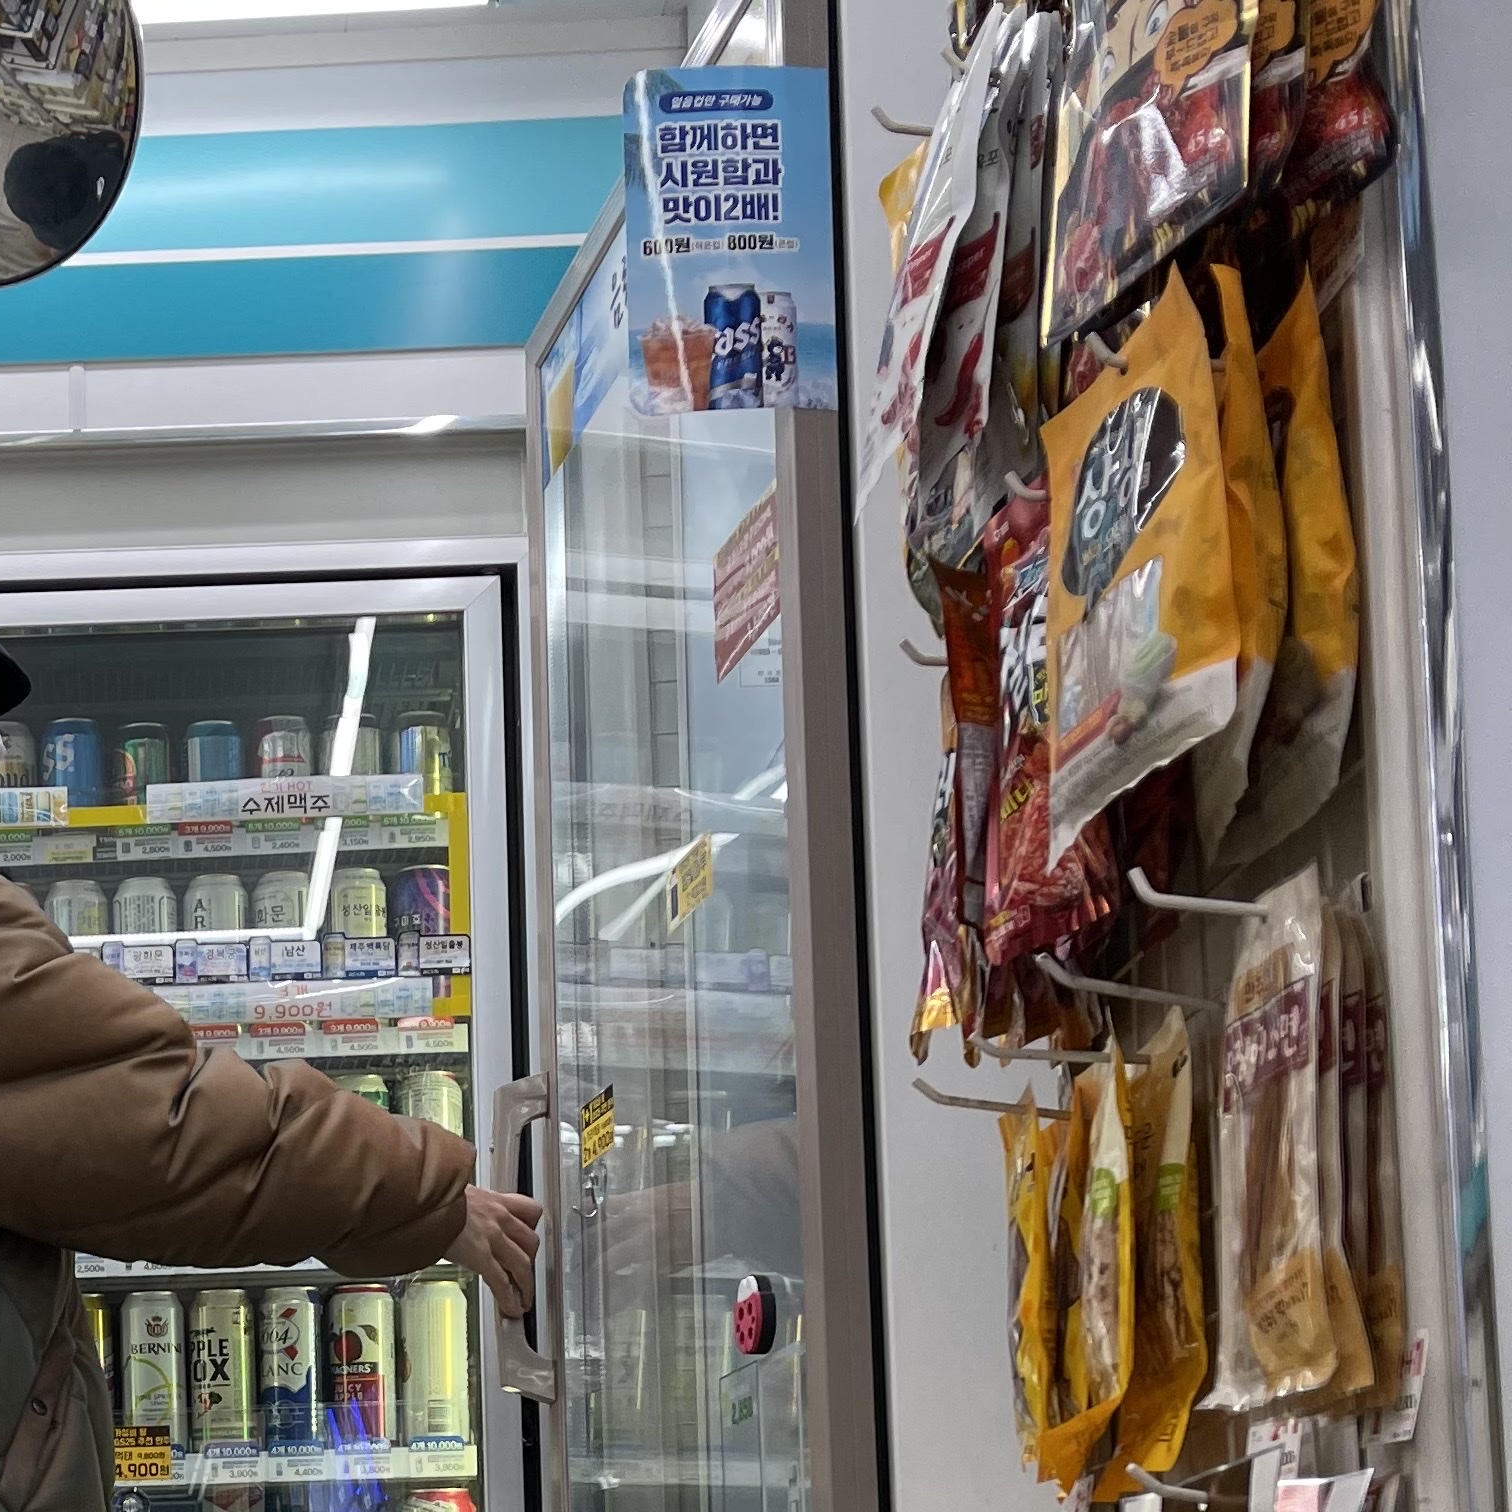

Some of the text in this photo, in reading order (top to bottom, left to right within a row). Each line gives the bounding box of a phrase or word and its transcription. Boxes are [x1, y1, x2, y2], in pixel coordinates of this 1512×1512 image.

[657, 121, 781, 154] 함께하면
[658, 156, 782, 189] 시원함과
[662, 192, 780, 225] 맛이2배!
[642, 233, 775, 257] 600원 800원
[714, 317, 762, 356] ass
[287, 780, 313, 792] HOT
[240, 792, 331, 816] 수제맥주
[254, 904, 286, 925] 화문
[284, 944, 306, 958] 남산
[254, 1002, 333, 1020] 9,900원
[130, 1342, 182, 1356] BERNINI
[190, 1338, 230, 1357] PPLE
[192, 1358, 231, 1382] OX
[262, 1361, 304, 1378] LANC
